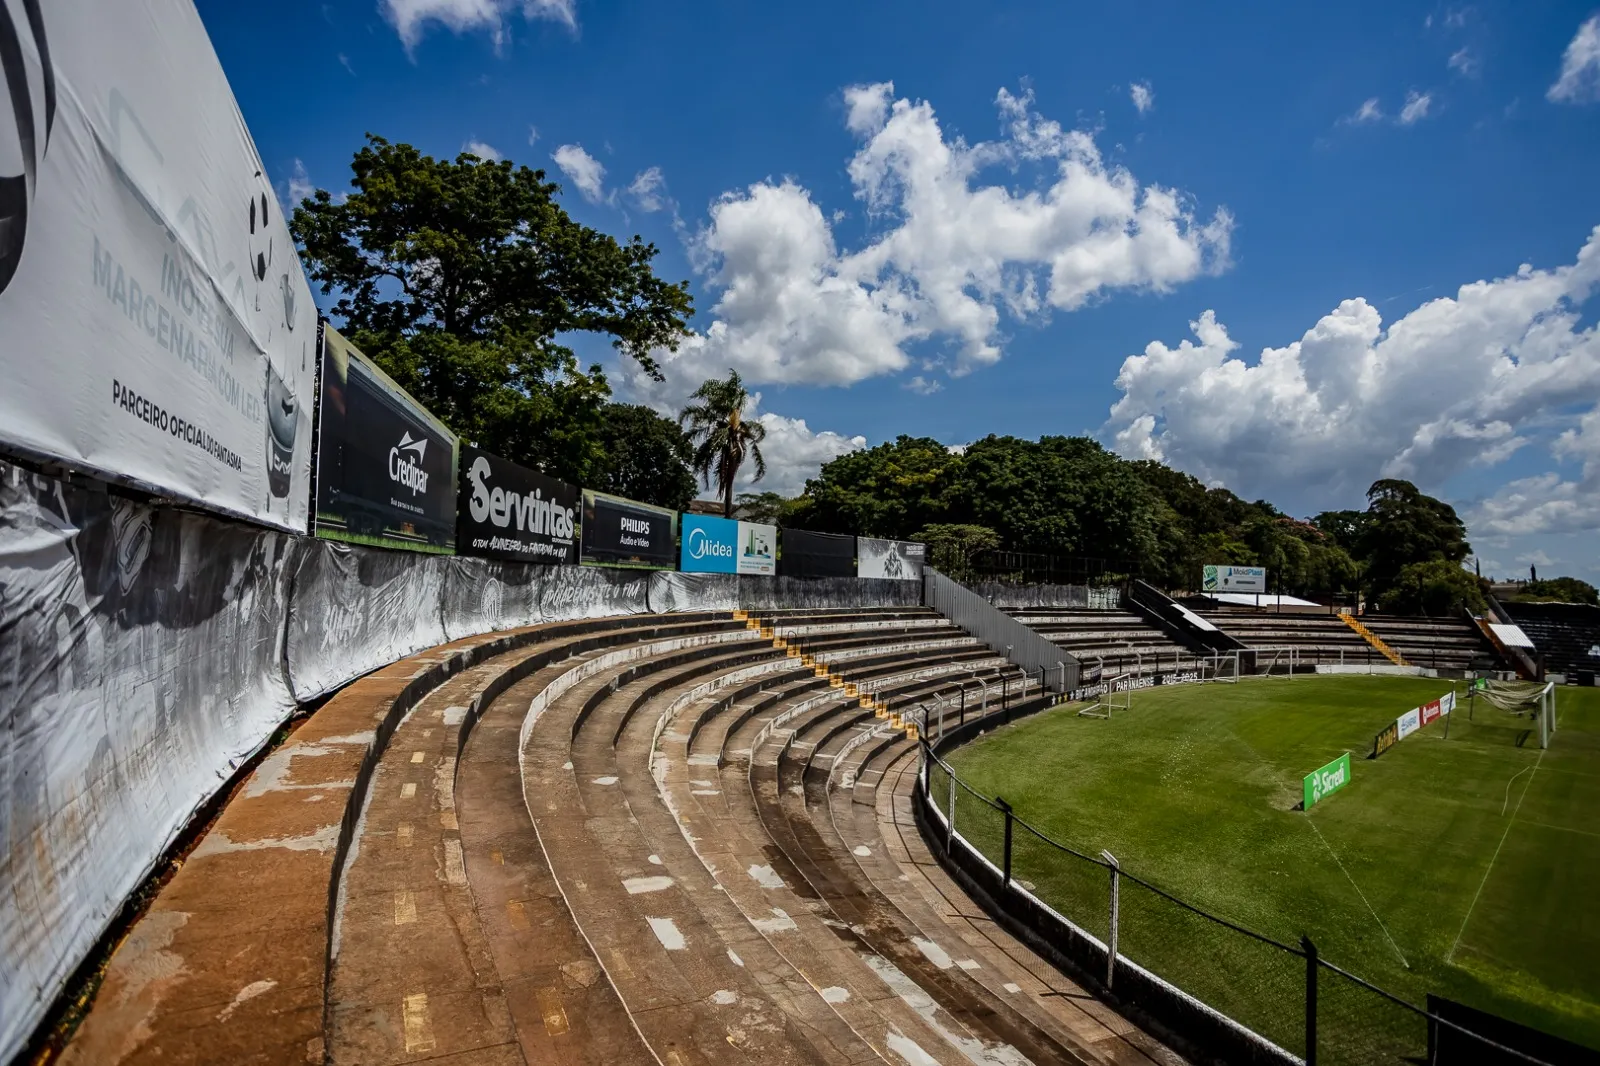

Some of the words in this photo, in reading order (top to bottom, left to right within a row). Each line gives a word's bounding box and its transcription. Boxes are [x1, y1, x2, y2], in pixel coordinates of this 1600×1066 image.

[218, 364, 240, 411] COM
[113, 378, 168, 432] PARCEIRO
[170, 415, 206, 450] OFICIAL
[206, 434, 214, 455] DO
[213, 441, 242, 472] FANTASMA
[389, 446, 428, 496] Credipar
[466, 456, 574, 539] Servtintas
[620, 516, 650, 535] PHILIPS
[620, 533, 634, 546] Áudio
[691, 533, 733, 558] Midea
[1116, 676, 1155, 692] PARANAENSE
[1321, 763, 1345, 795] Sicredi
